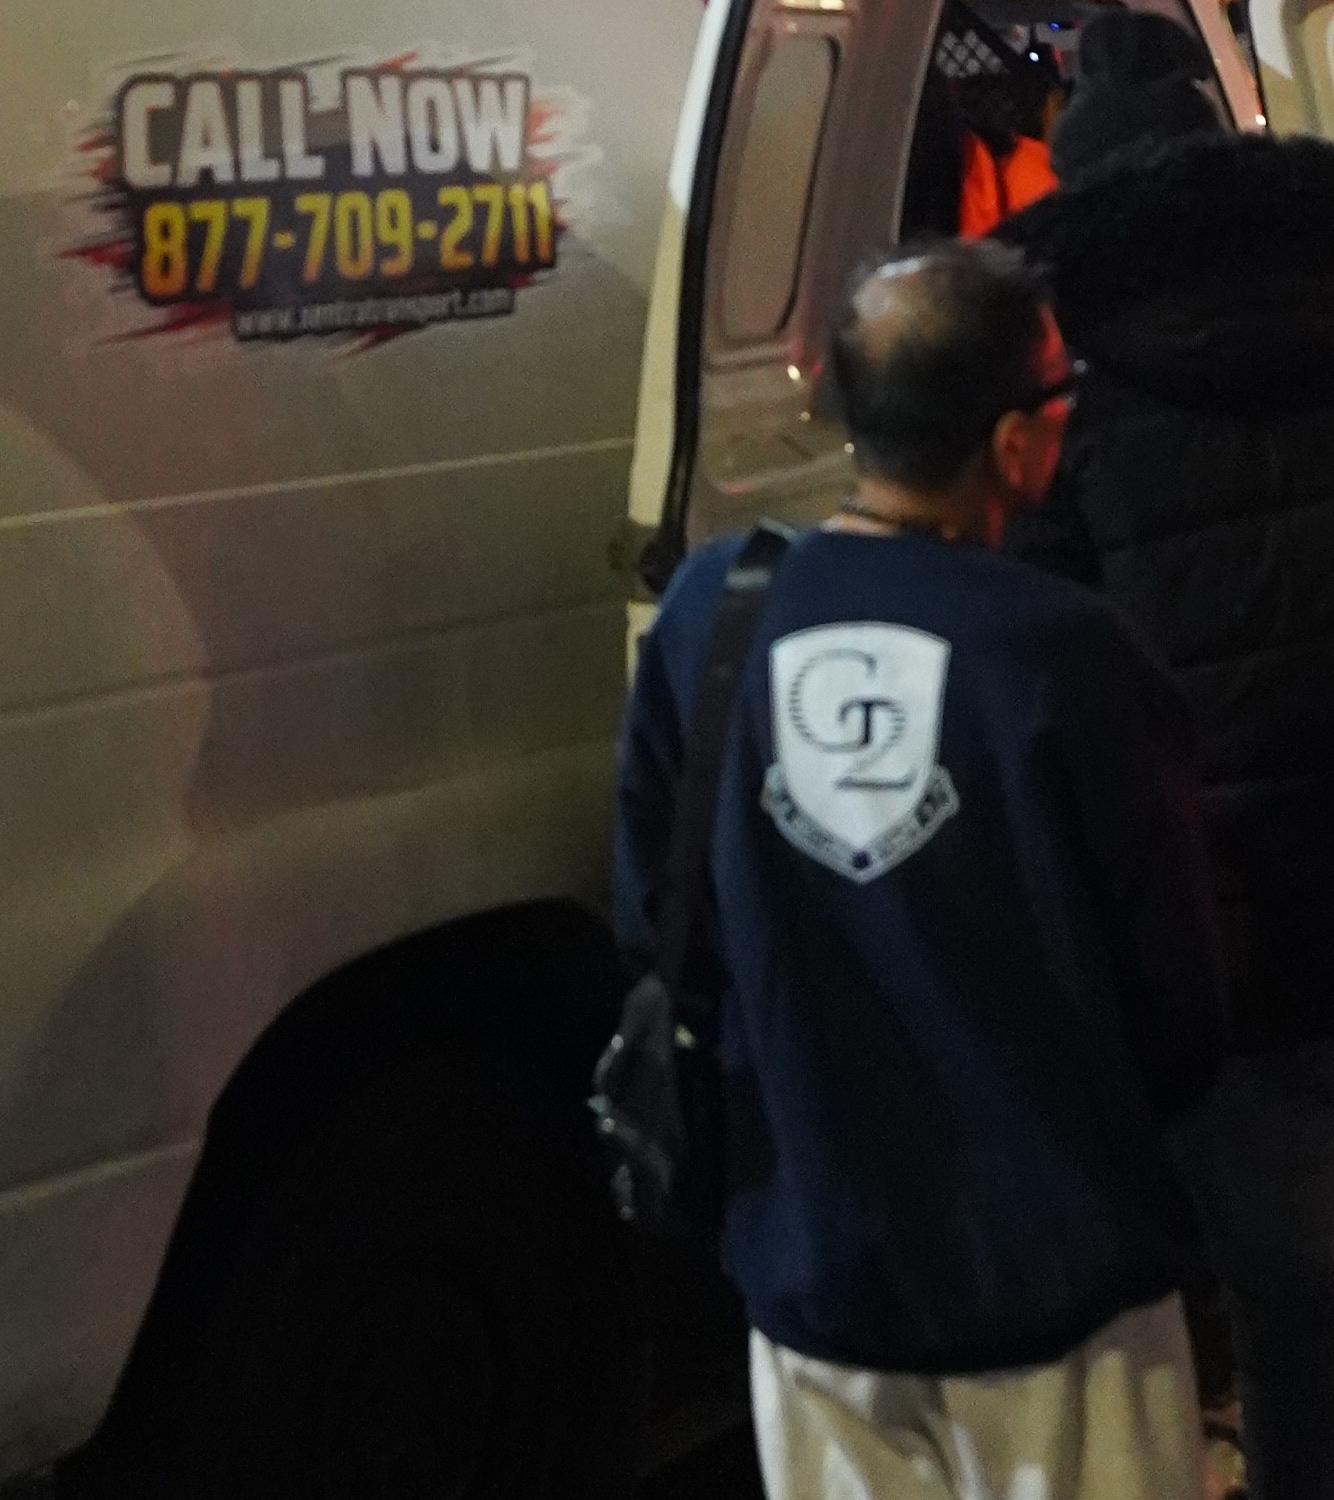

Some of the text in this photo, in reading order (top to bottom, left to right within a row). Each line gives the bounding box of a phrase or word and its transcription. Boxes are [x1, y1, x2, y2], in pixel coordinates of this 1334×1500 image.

[121, 73, 527, 189] CALL NOW
[139, 181, 555, 299] 877-709-2711
